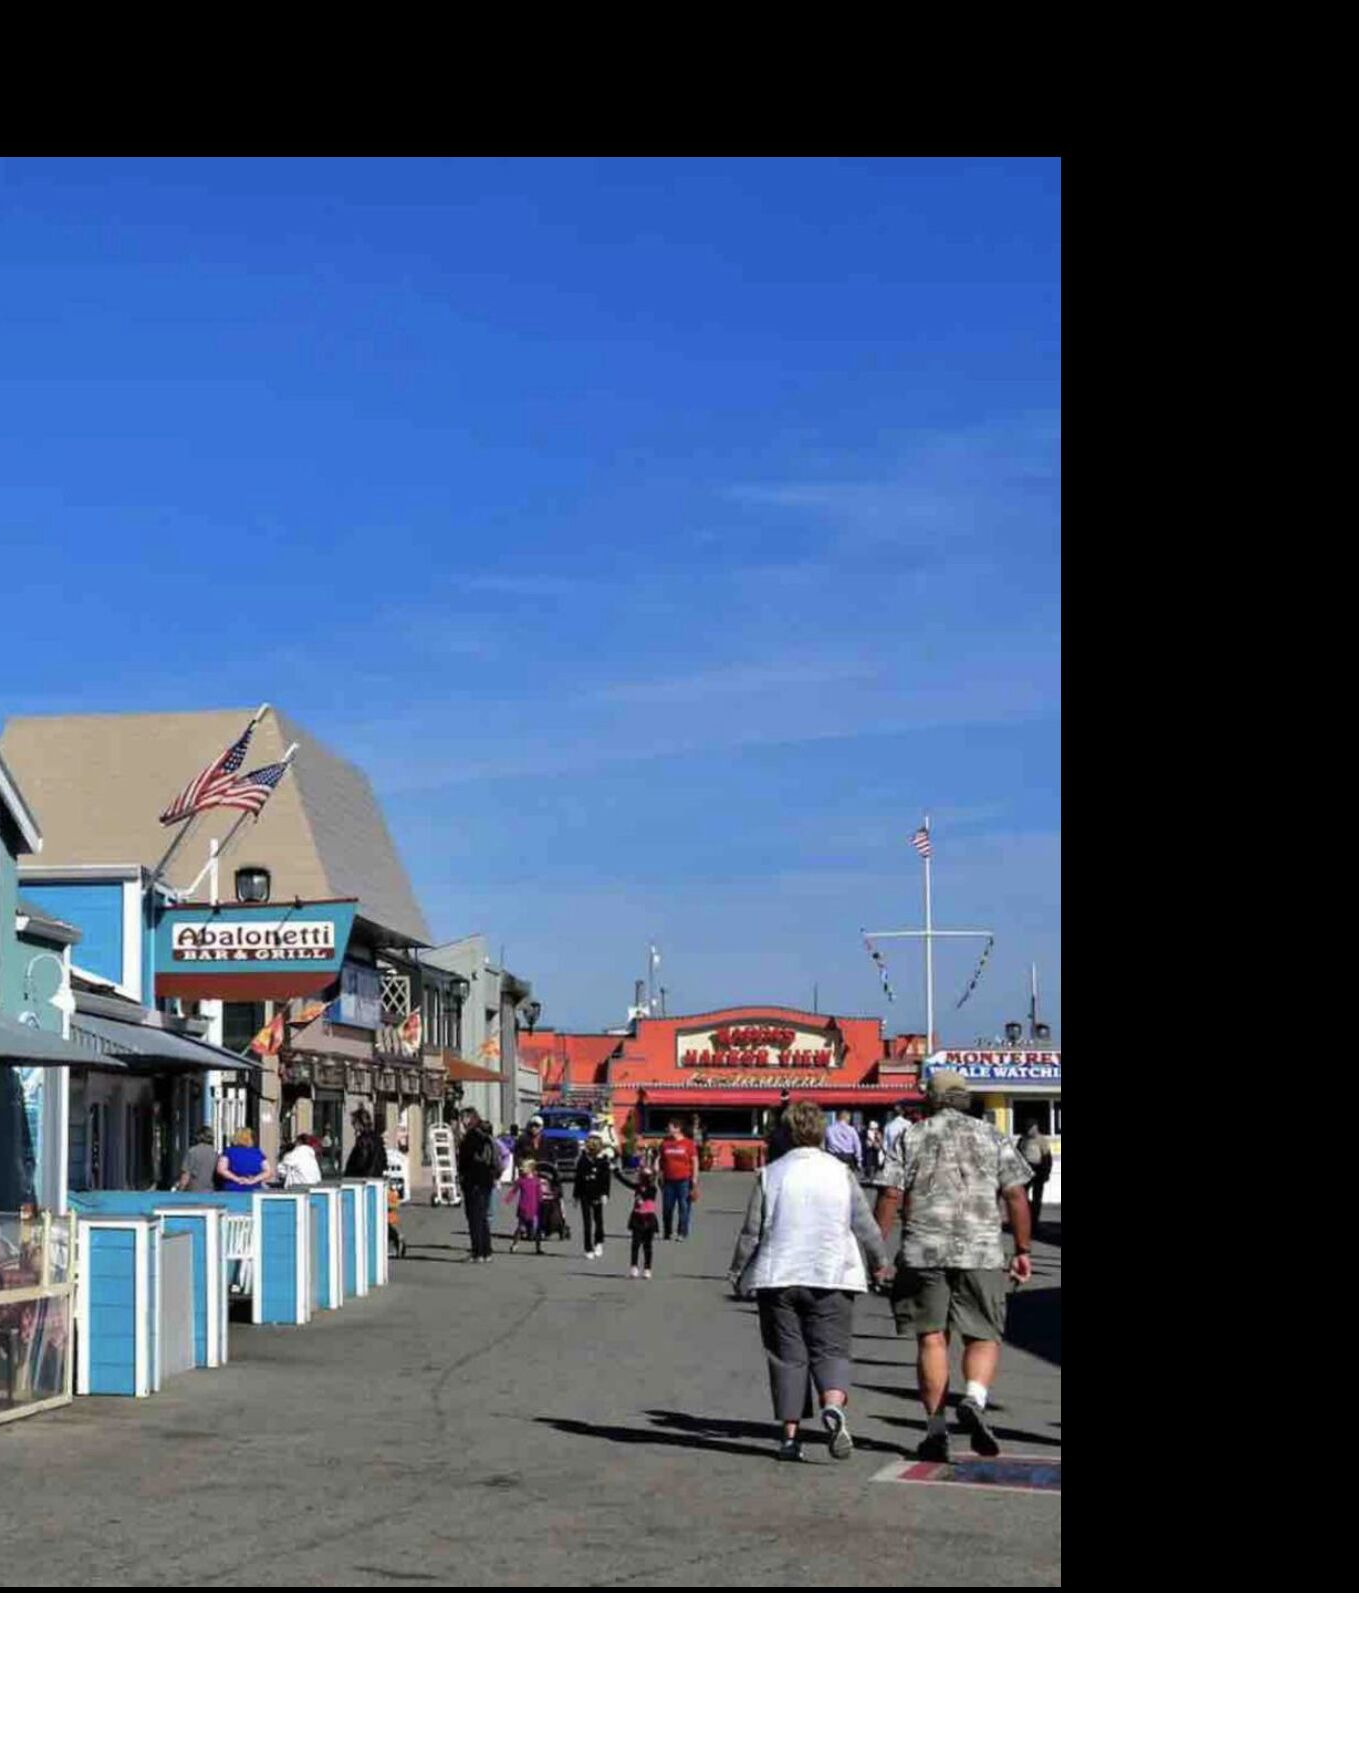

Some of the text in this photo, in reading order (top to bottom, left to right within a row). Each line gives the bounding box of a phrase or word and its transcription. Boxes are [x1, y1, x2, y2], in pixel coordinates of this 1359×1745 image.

[177, 925, 331, 947] Abalonetti
[183, 949, 327, 960] BAR & GRILL
[993, 1066, 1061, 1078] WATCHI
